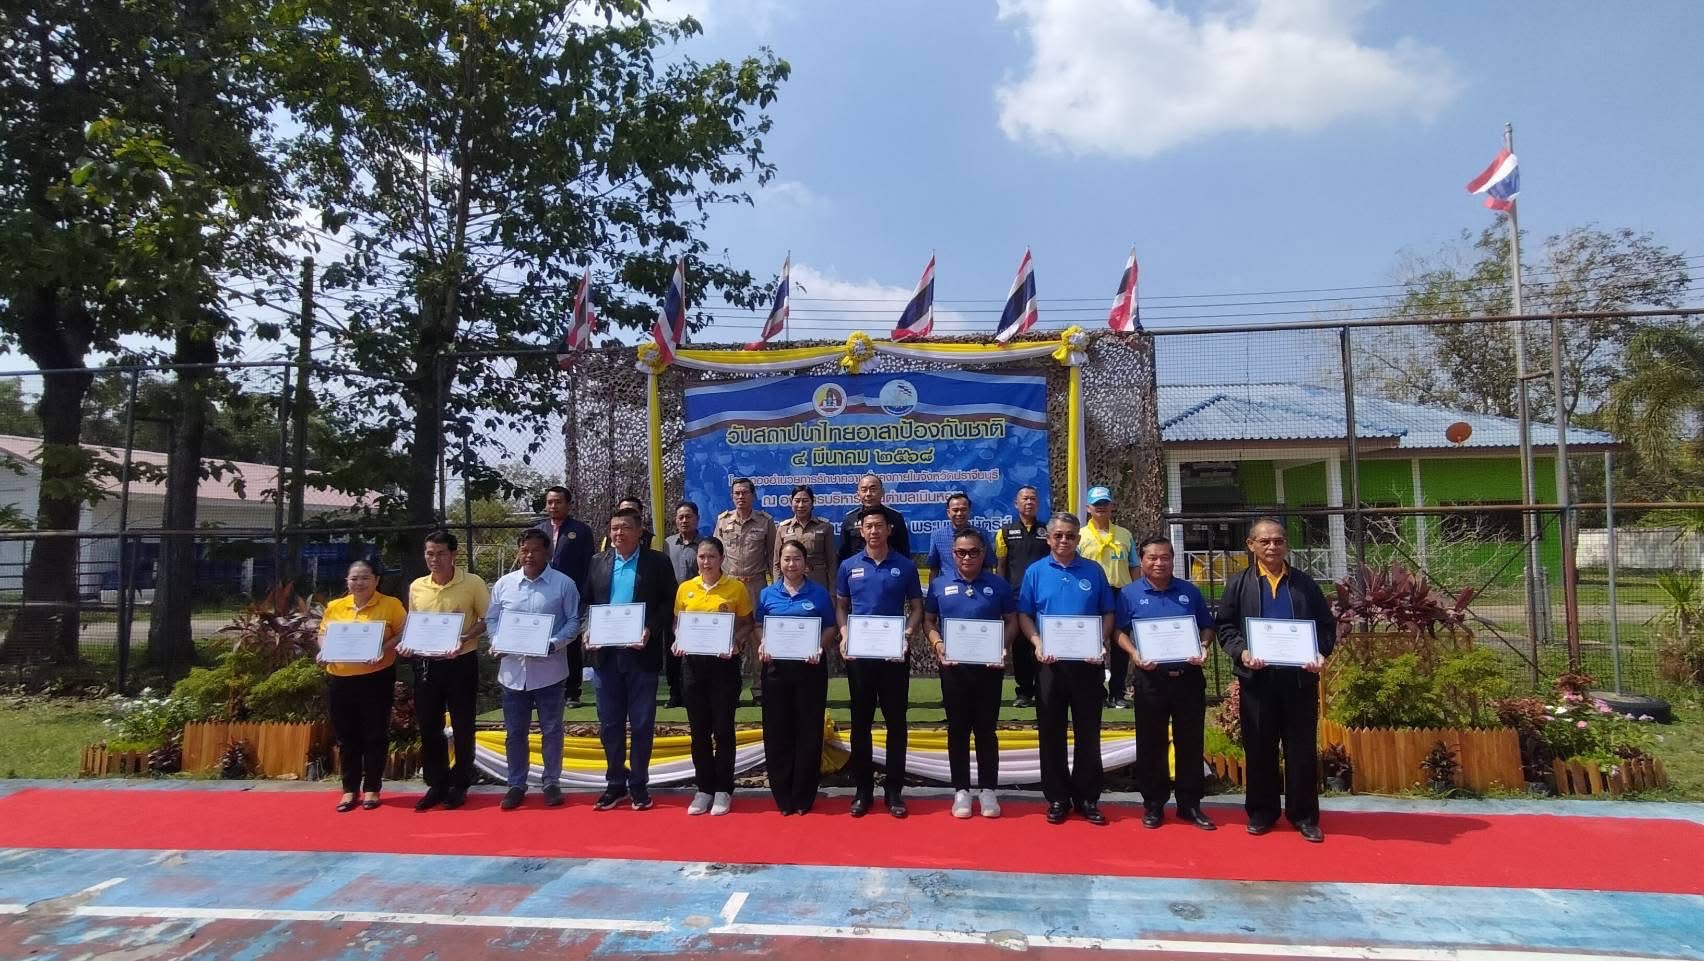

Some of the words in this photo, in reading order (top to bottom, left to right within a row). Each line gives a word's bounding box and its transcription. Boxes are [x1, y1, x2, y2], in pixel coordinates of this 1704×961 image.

[727, 418, 1005, 445] วันสถาปนาไทยอาสาป้องกันชาติ
[791, 449, 808, 466] ๔
[813, 446, 870, 465] มีนาคม
[875, 447, 934, 465] ๒๕๖๘
[762, 494, 777, 507] ณ
